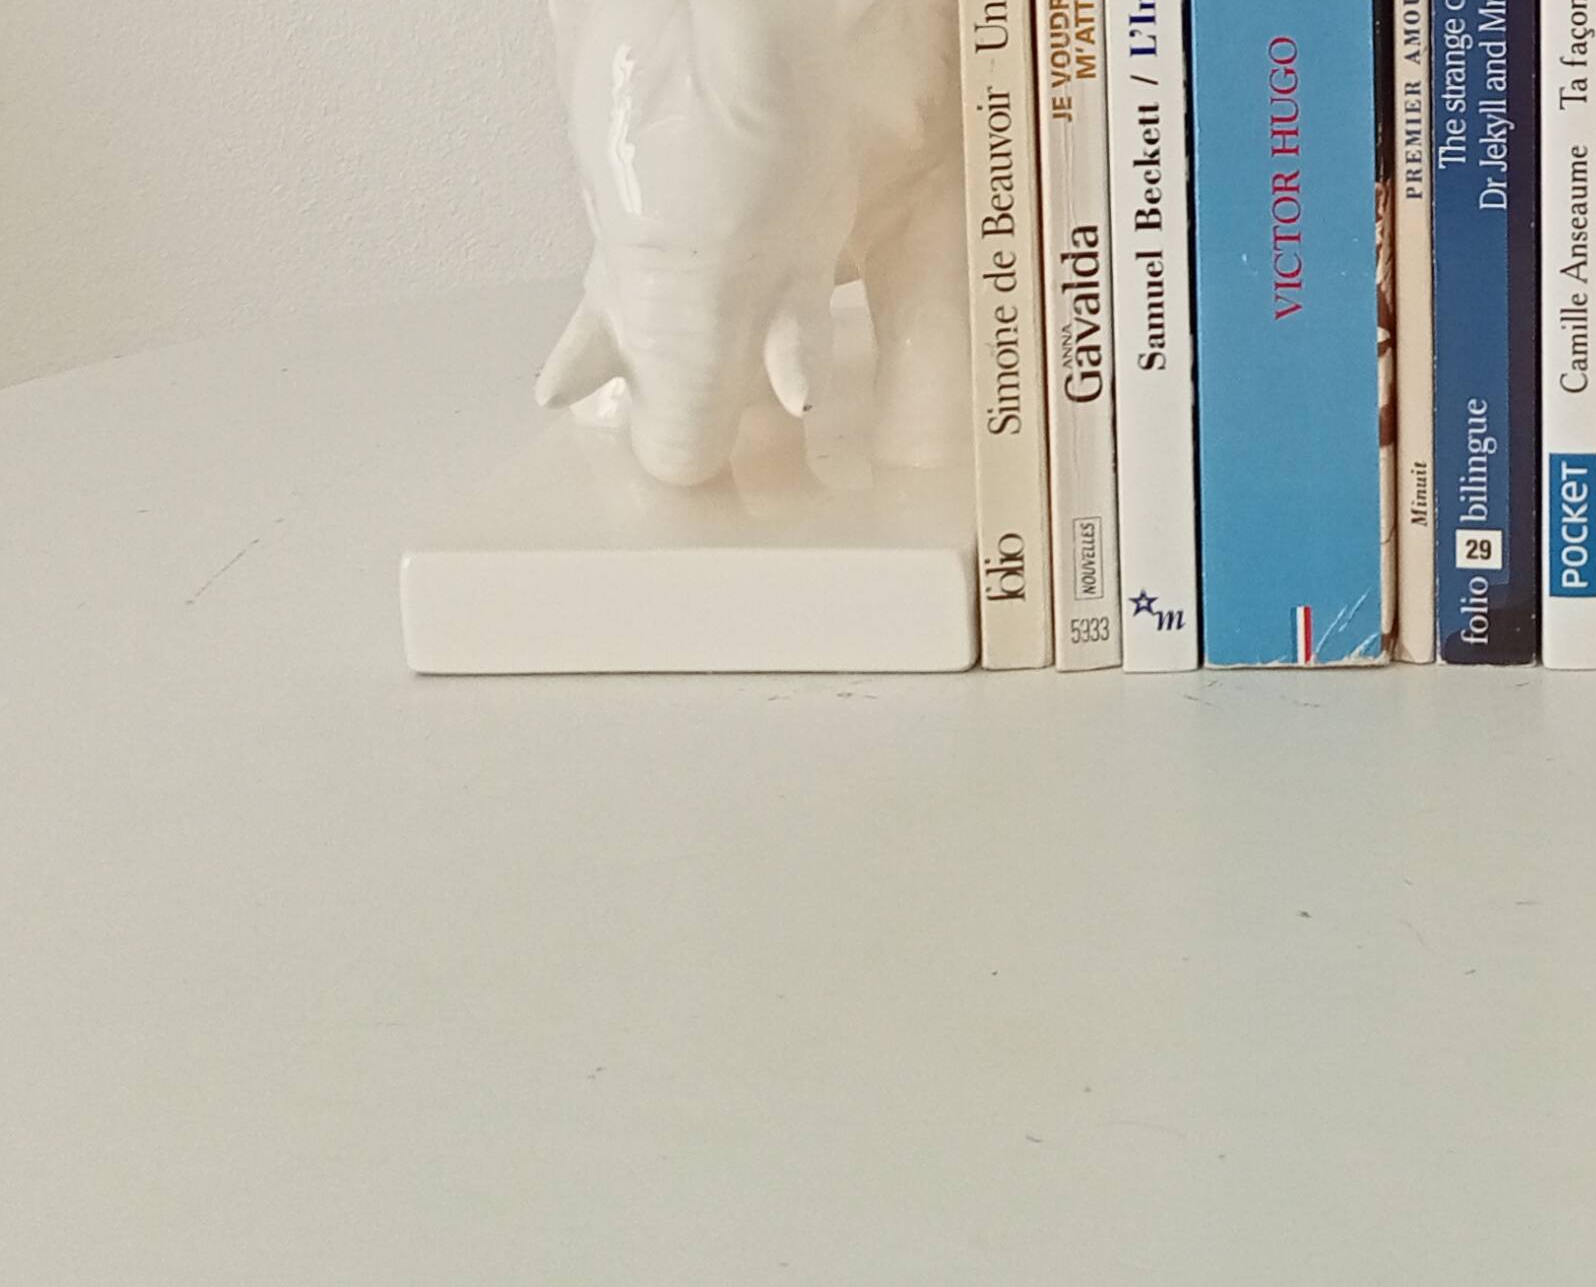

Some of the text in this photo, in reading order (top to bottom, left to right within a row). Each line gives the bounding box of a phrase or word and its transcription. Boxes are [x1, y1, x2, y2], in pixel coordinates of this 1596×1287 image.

[1443, 18, 1472, 113] strange
[1478, 41, 1507, 91] and
[1560, 77, 1588, 110] Ta
[1052, 96, 1073, 122] JE
[1405, 81, 1423, 198] PREMIER
[1437, 119, 1466, 169] The
[1479, 99, 1514, 173] Jekyll
[976, 86, 1017, 239] Beauvoir
[1134, 101, 1163, 232] Beckett
[1268, 36, 1303, 321] VICTOR HUGO
[1479, 177, 1507, 210] Dr
[1560, 144, 1588, 283] Anseaume
[984, 250, 1017, 292] de
[1060, 224, 1103, 403] Gavalda
[1062, 324, 1074, 371] ANNA
[1138, 250, 1166, 371] Samuel
[1559, 290, 1588, 393] Camille
[987, 305, 1021, 435] Simone
[1411, 460, 1428, 527] Minuit
[1459, 396, 1497, 645] folio 29 bilingue
[985, 532, 1026, 604] folio
[1080, 522, 1097, 594] NOUVELLES
[1071, 616, 1110, 643] 5333
